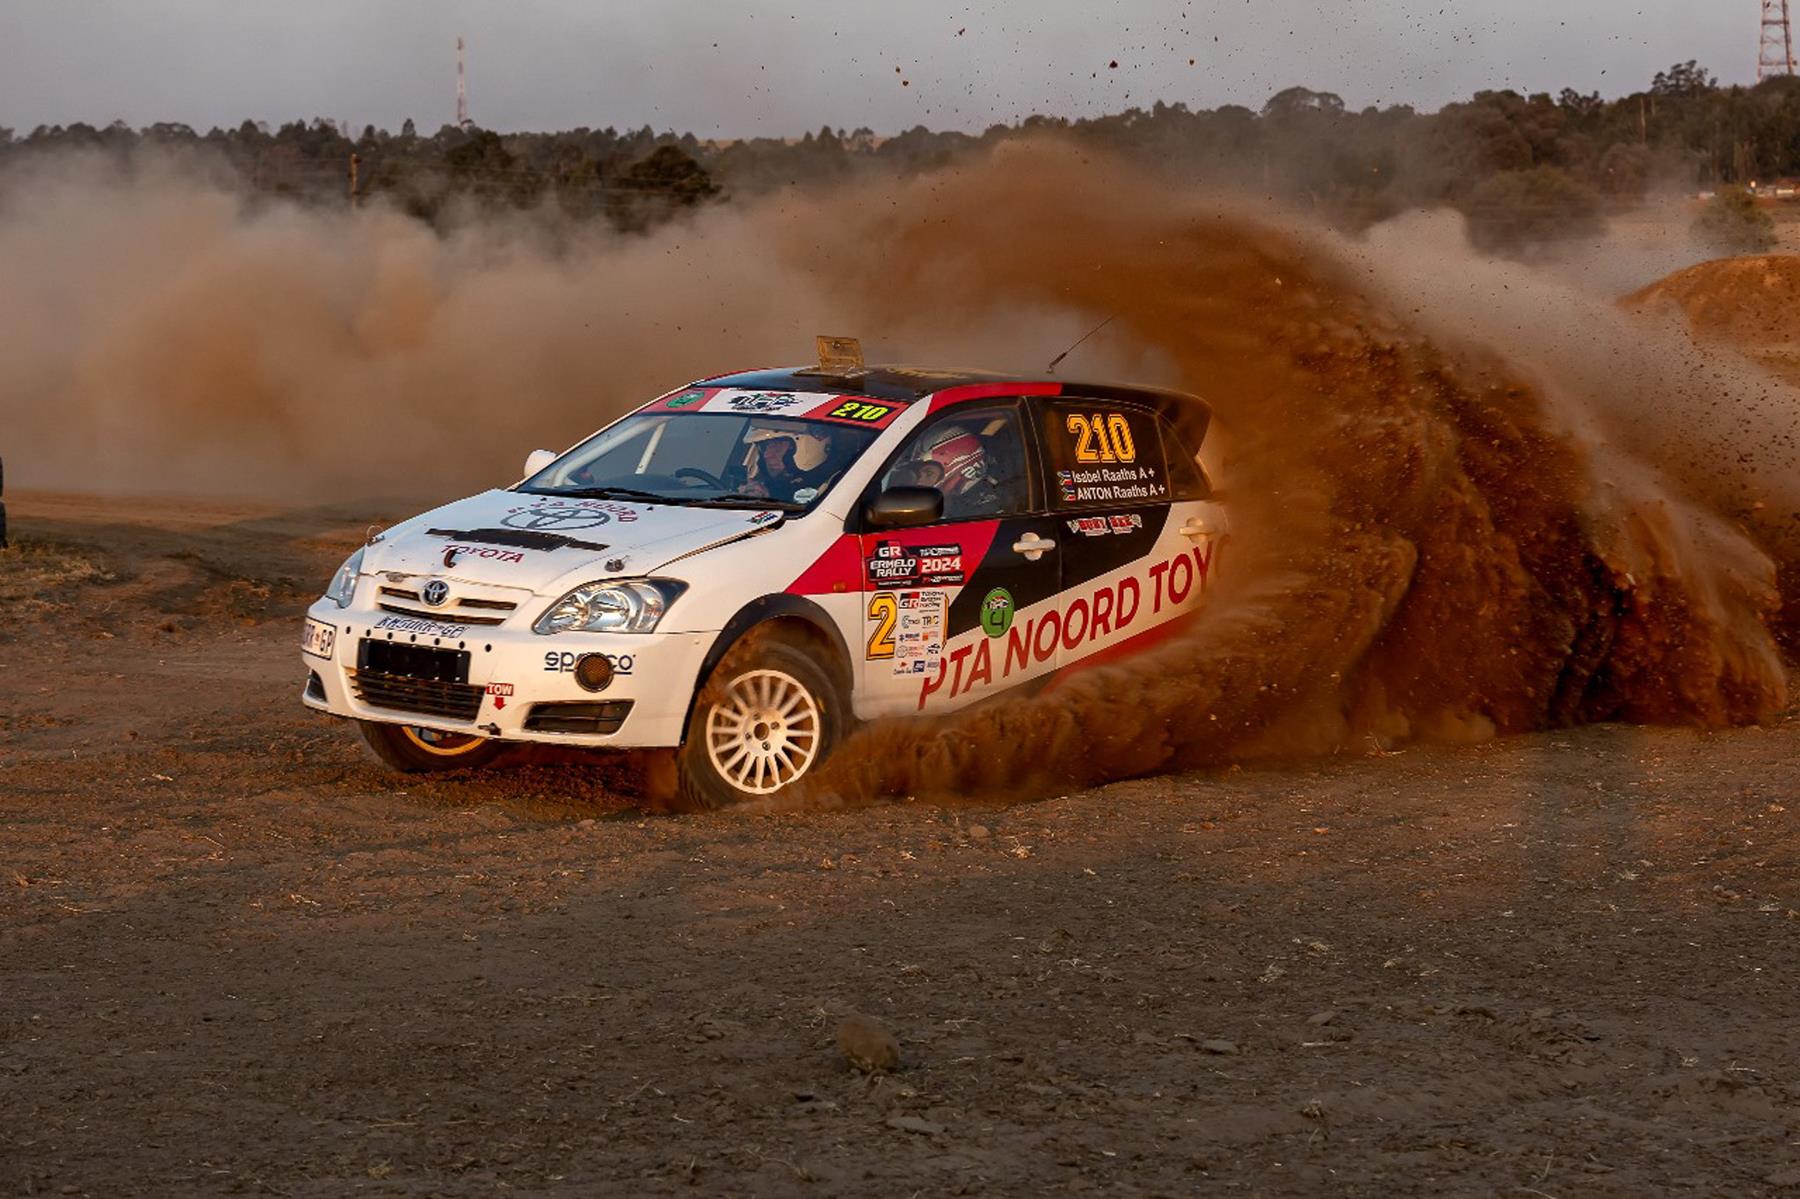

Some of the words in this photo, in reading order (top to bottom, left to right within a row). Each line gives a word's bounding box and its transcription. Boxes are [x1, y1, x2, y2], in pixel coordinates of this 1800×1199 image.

[832, 402, 888, 421] 210
[1067, 414, 1136, 463] 210
[1072, 469, 1101, 483] Isabel
[1102, 467, 1137, 482] Raaths
[1077, 487, 1113, 501] ANTON
[1113, 484, 1148, 499] Raaths
[879, 546, 902, 559] GR
[870, 559, 916, 570] ERMELO
[876, 567, 912, 578] RALLY
[921, 557, 961, 573] 2024
[990, 611, 1005, 630] 4
[916, 638, 992, 711] PTA
[1003, 576, 1140, 679] NOORD
[487, 684, 513, 696] TOW
